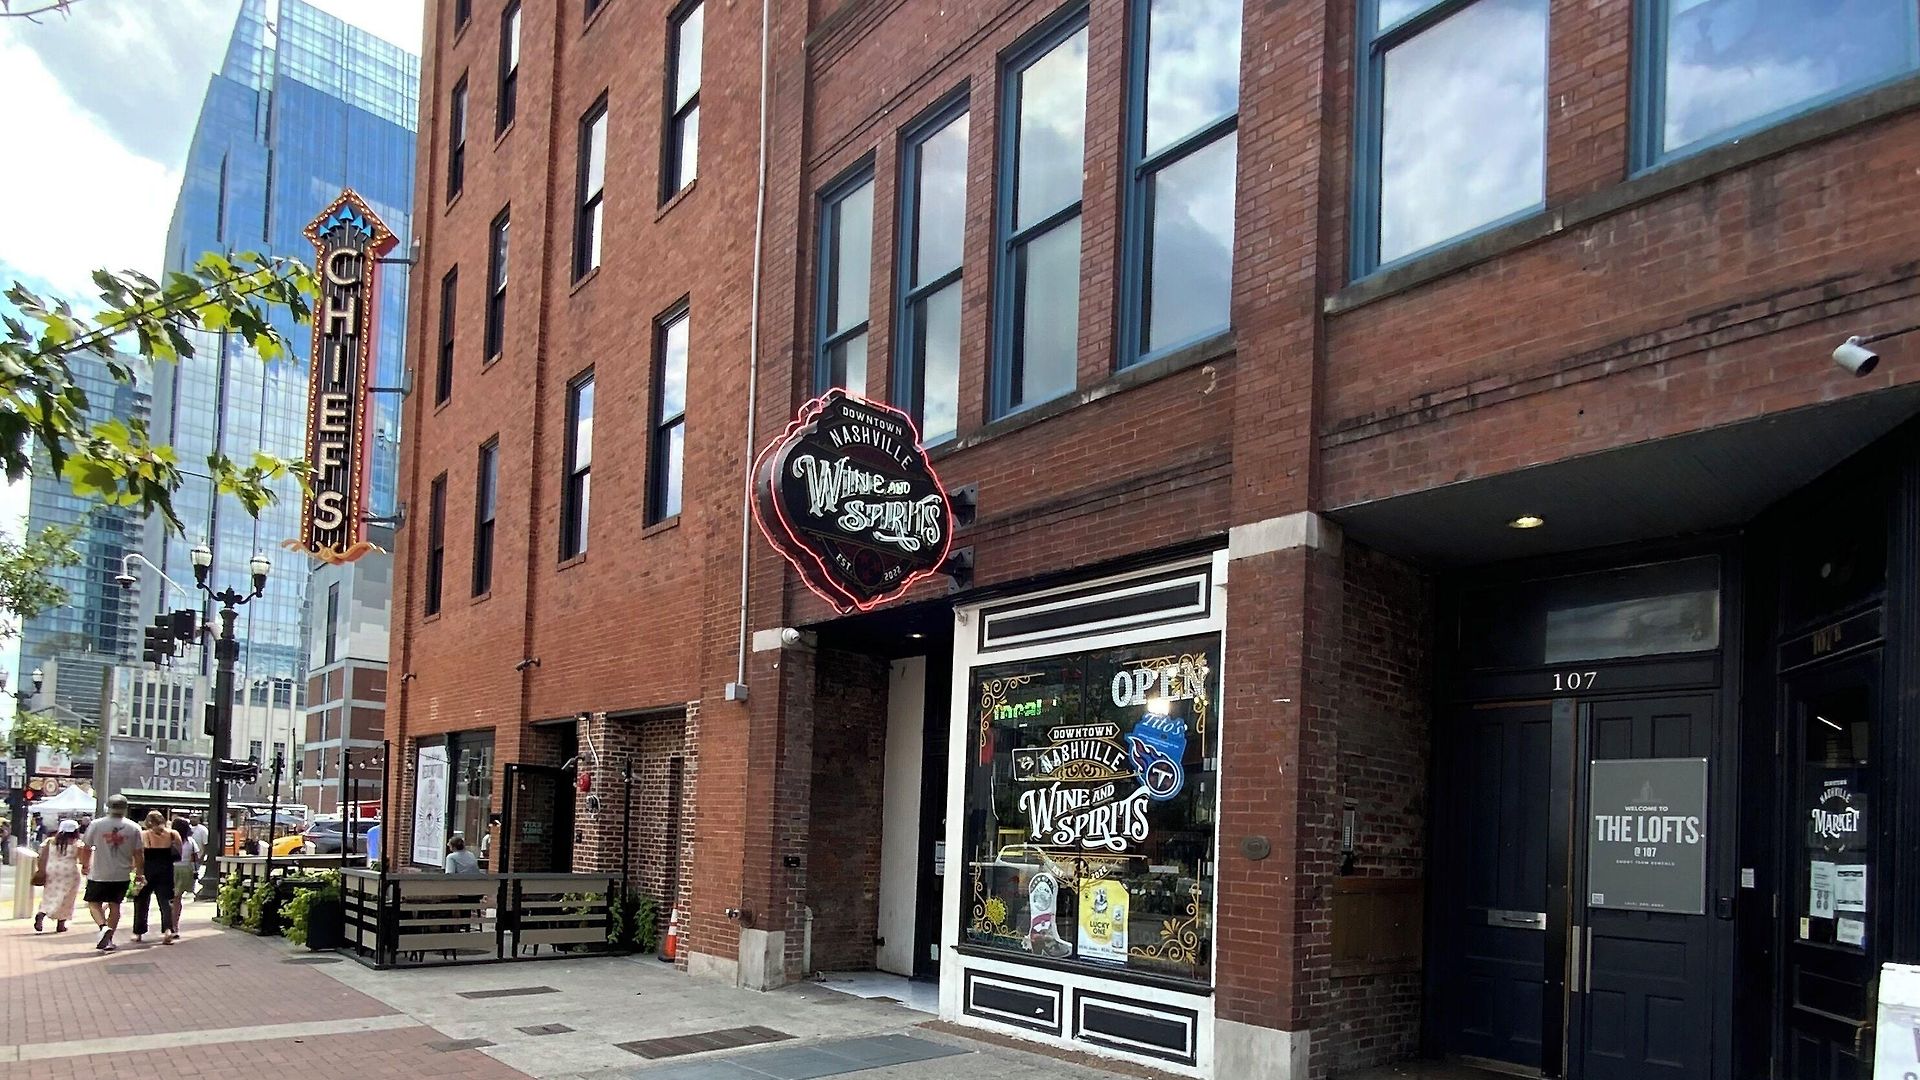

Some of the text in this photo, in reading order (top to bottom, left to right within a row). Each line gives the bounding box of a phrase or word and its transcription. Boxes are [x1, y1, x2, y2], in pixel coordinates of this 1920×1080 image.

[314, 248, 359, 531] CHIEFS
[842, 406, 903, 436] DOWNTOWN
[829, 425, 914, 472] NASHVILLE
[792, 454, 911, 517] WINE AND
[837, 494, 942, 552] SPIRITS
[884, 565, 902, 581] 2022
[1112, 662, 1209, 708] OPEN
[1552, 672, 1597, 691] 107
[1053, 725, 1113, 739] DOWNTOWN
[1142, 713, 1184, 735] Tito's
[154, 756, 210, 777] POSIT
[1040, 739, 1125, 774] NASHVILLE
[139, 776, 197, 792] VIBES
[1819, 787, 1852, 804] NASHVILLE
[1018, 781, 1115, 841] WINE AND
[1052, 785, 1151, 851] SPIRITS
[1812, 807, 1860, 838] MARKET
[1595, 815, 1699, 844] THE LOFTS
[1634, 847, 1657, 857] @ 107
[1091, 865, 1108, 879] 2022
[1089, 920, 1110, 929] LUCKY
[1092, 927, 1106, 936] ONE
